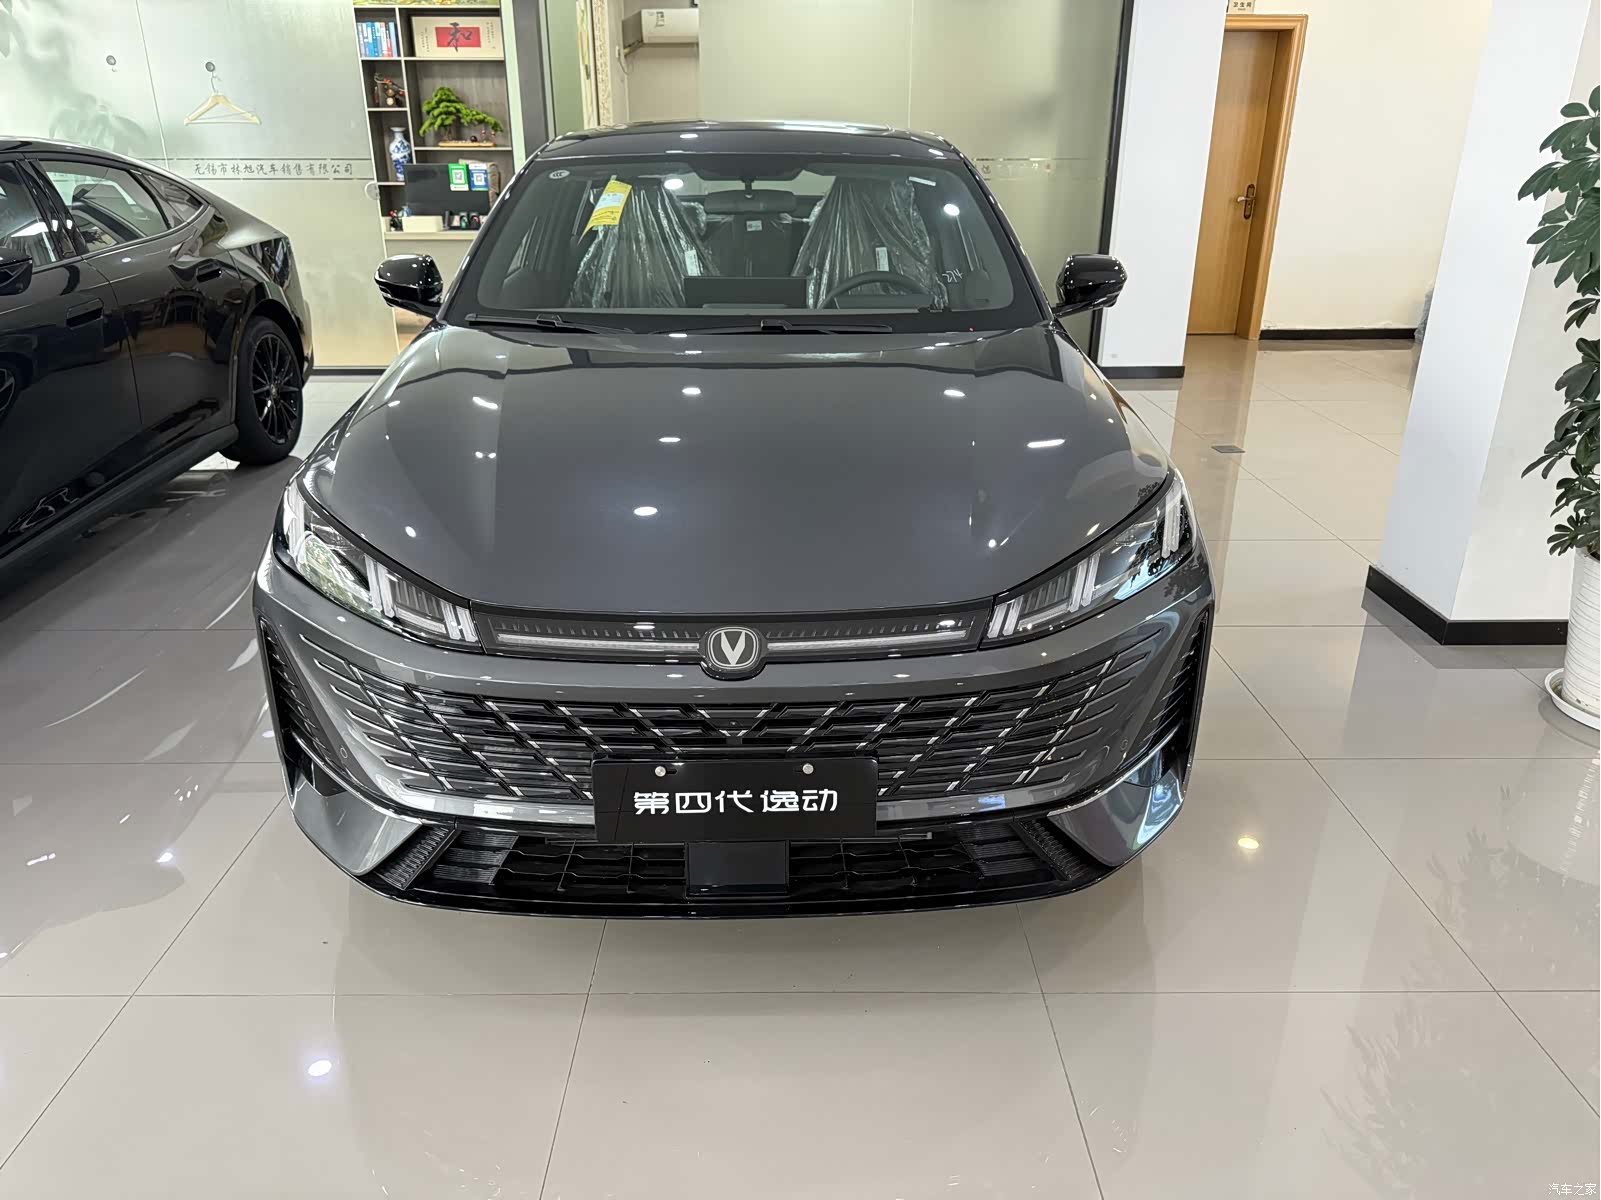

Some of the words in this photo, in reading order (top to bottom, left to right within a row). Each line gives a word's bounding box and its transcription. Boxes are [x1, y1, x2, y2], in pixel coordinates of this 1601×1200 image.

[447, 22, 473, 52] 和
[194, 162, 353, 176] 无锡市林旭汽车销售有限公司
[633, 788, 838, 815] 第四代逸动
